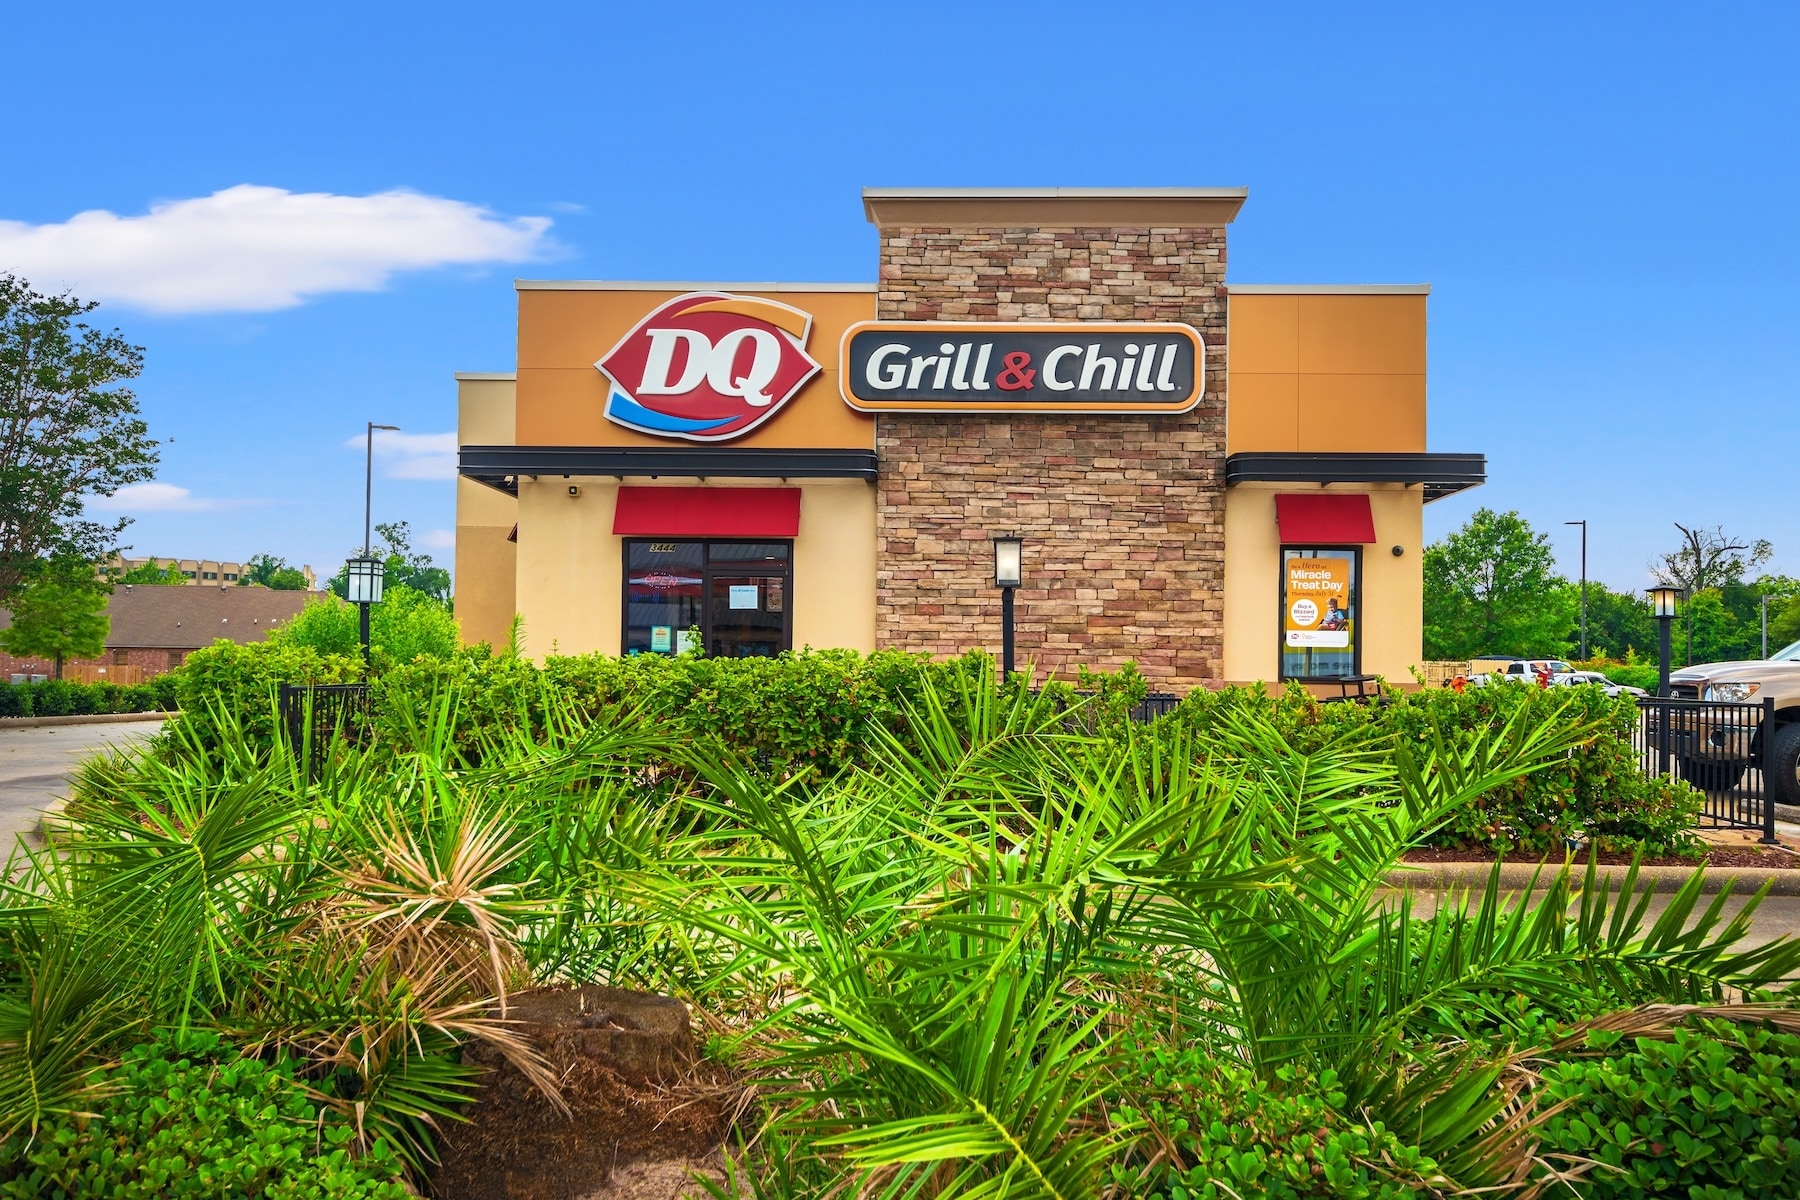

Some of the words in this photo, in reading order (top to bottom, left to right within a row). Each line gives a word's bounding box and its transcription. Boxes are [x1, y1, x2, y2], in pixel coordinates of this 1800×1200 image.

[635, 328, 782, 407] DQ
[865, 341, 993, 391] Grill
[995, 350, 1035, 391] &
[1041, 341, 1179, 391] Chill
[650, 544, 676, 552] 3444
[1291, 570, 1331, 579] Miracle
[644, 575, 678, 586] OPEN
[1291, 580, 1320, 590] Treat
[1321, 580, 1344, 592] Day
